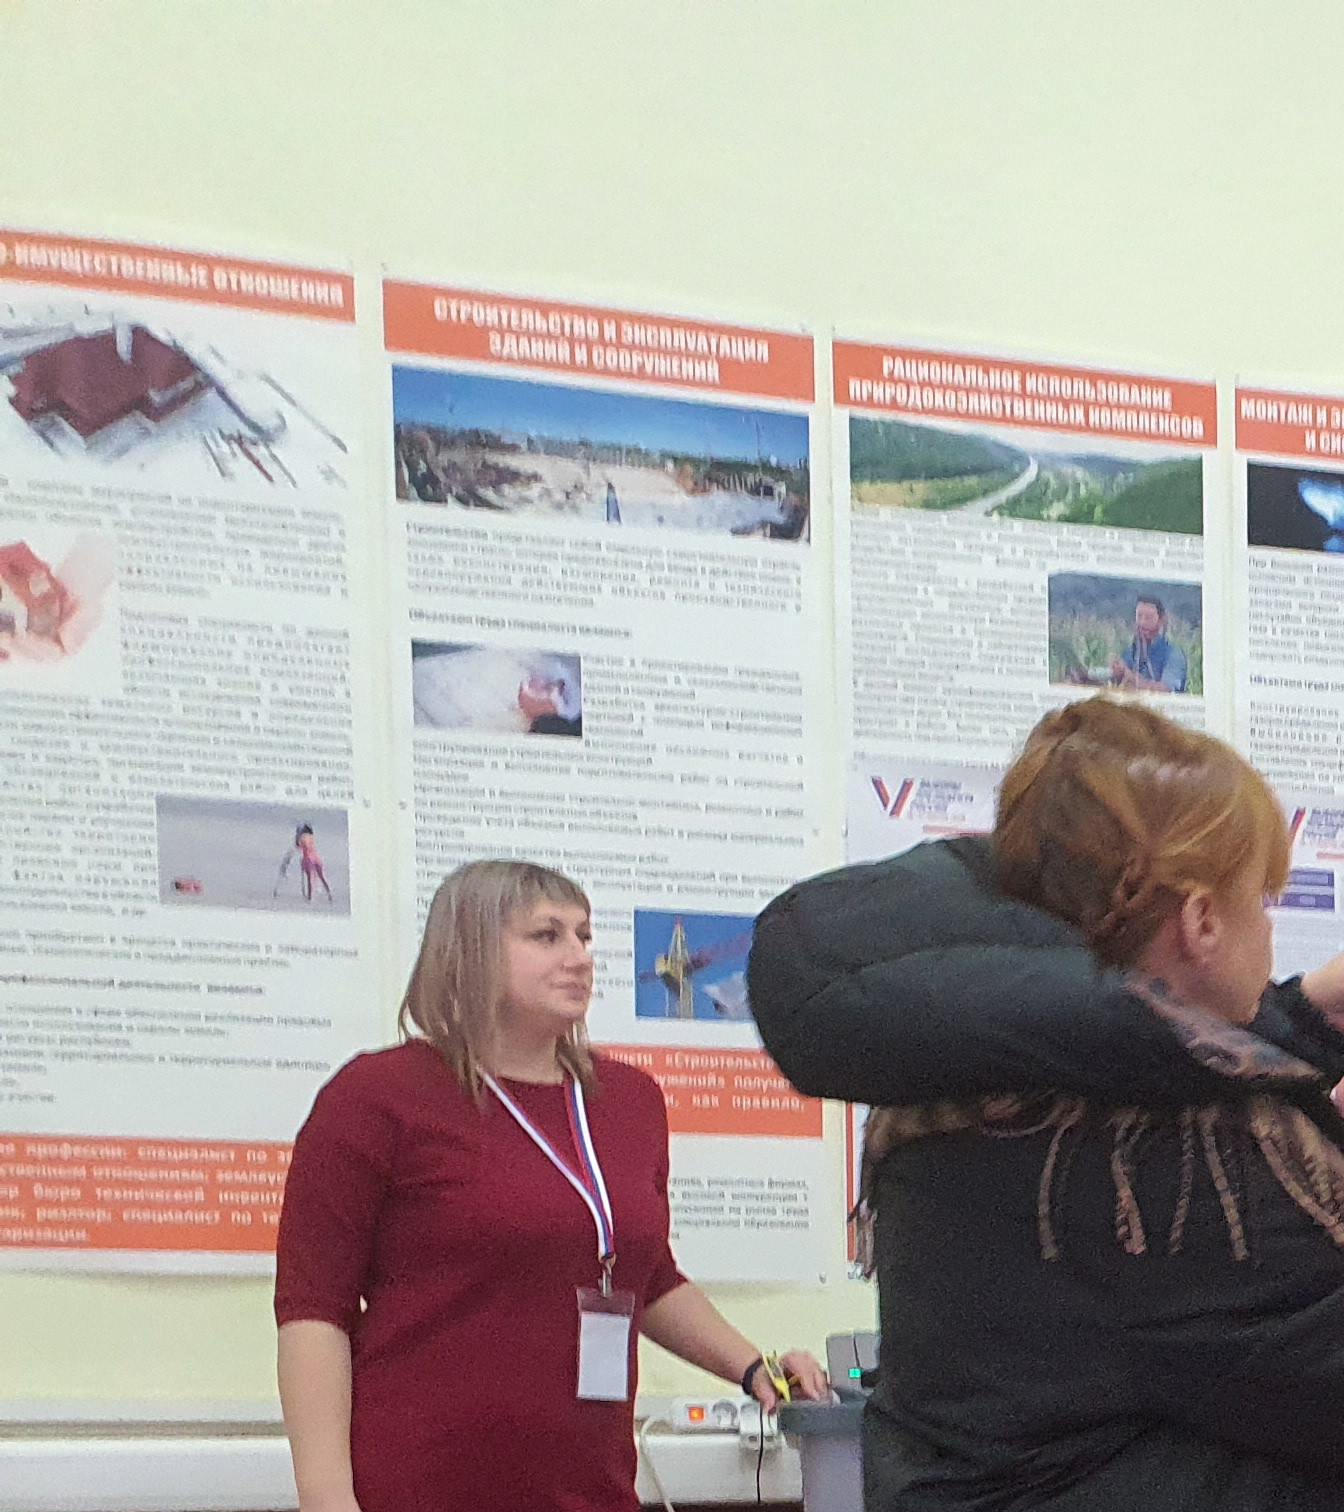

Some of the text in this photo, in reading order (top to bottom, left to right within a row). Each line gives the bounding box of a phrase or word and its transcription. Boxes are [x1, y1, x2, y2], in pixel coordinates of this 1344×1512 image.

[433, 296, 769, 363] СТРОИТЕЛЬСТВО И ЭКСПЛУАТАЦИЯ
[489, 330, 719, 384] ЗДАНИЙ И СООРУЖЕНИЙ
[883, 355, 1172, 411] РАЦИОНАЛЬНОЕ ИСПОЛЬЗОВАНИЕ
[1088, 406, 1204, 439] КОМПЛЕКСОВ
[1240, 398, 1313, 425] МОНТАЖ
[1316, 406, 1327, 428] И
[1305, 430, 1316, 452] И
